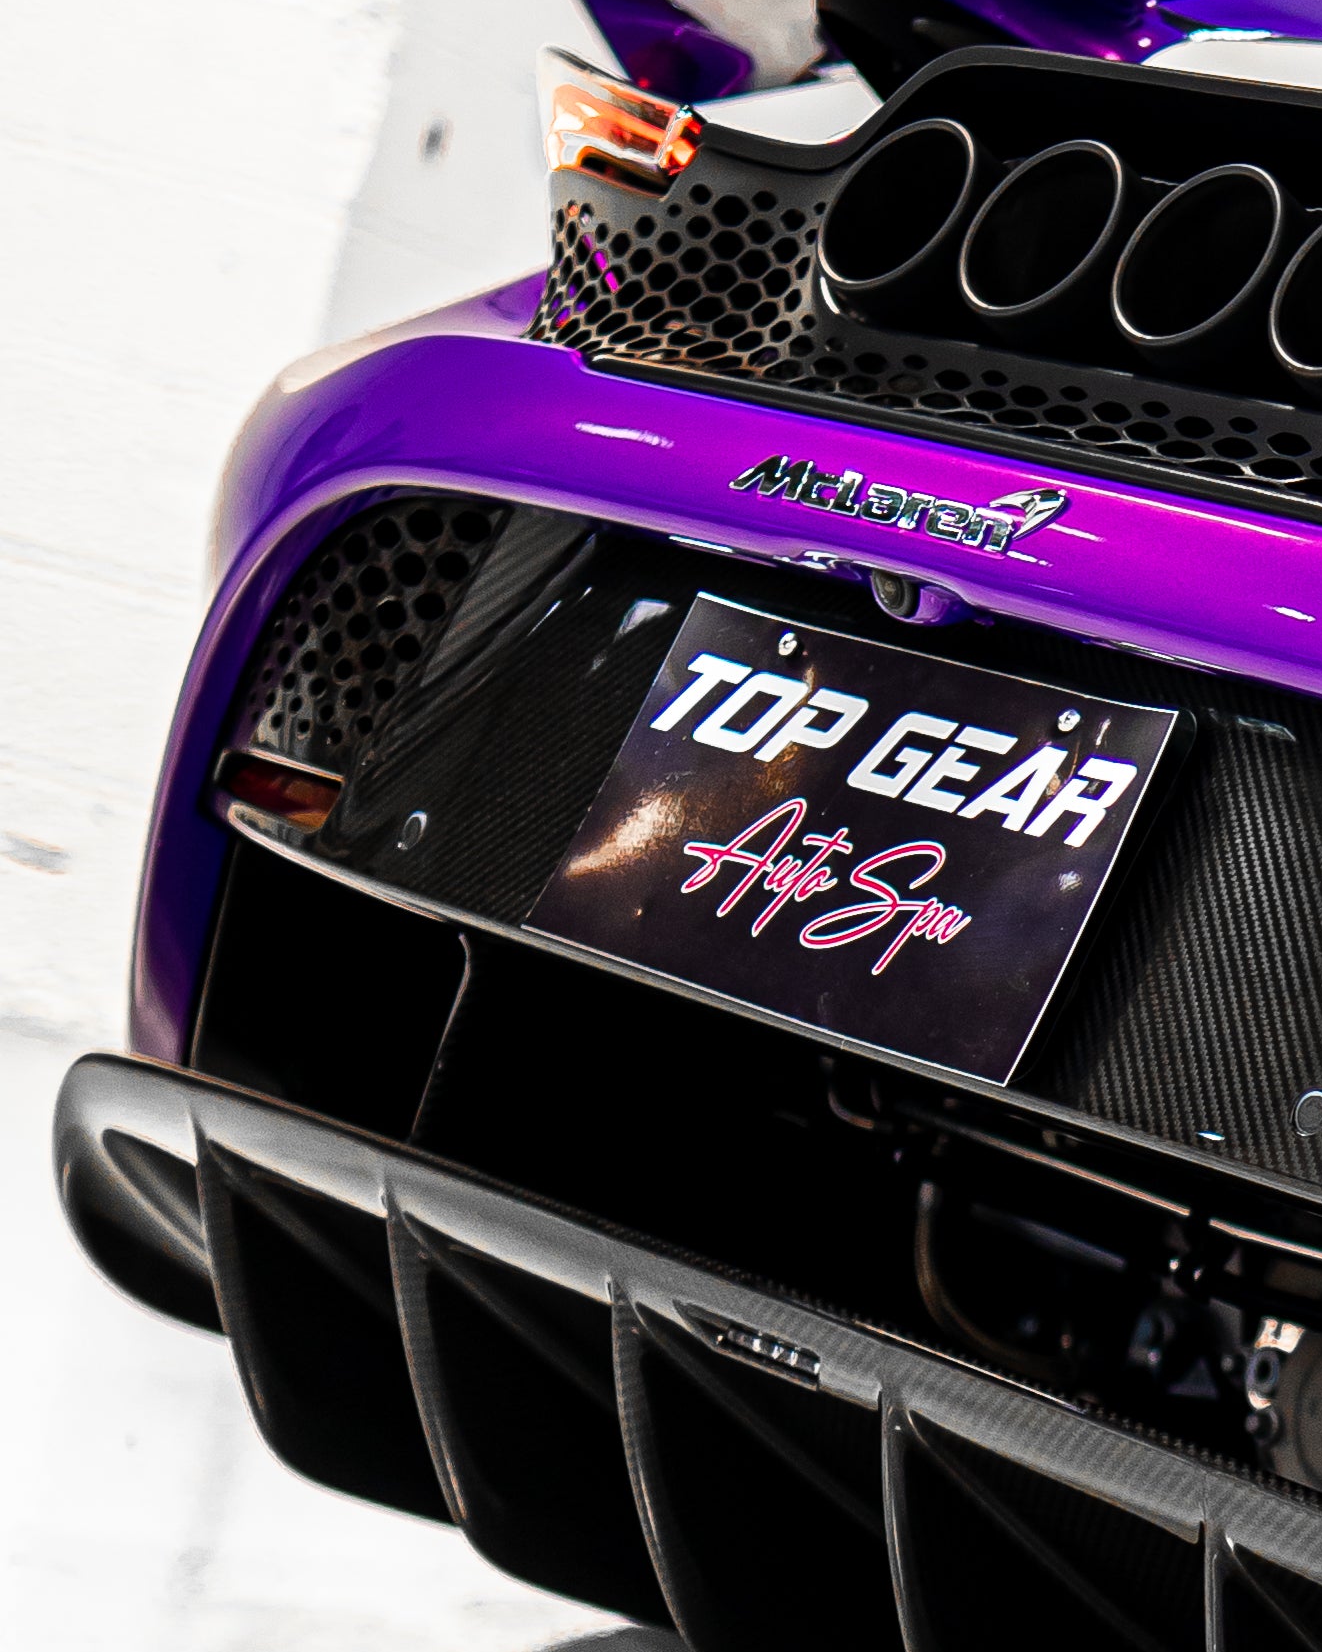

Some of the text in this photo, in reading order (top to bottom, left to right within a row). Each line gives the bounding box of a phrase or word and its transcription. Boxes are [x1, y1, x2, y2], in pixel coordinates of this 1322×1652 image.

[729, 454, 1015, 554] McLaren
[650, 653, 1138, 848] TOP GEAR
[681, 798, 972, 975] Auto Spa
